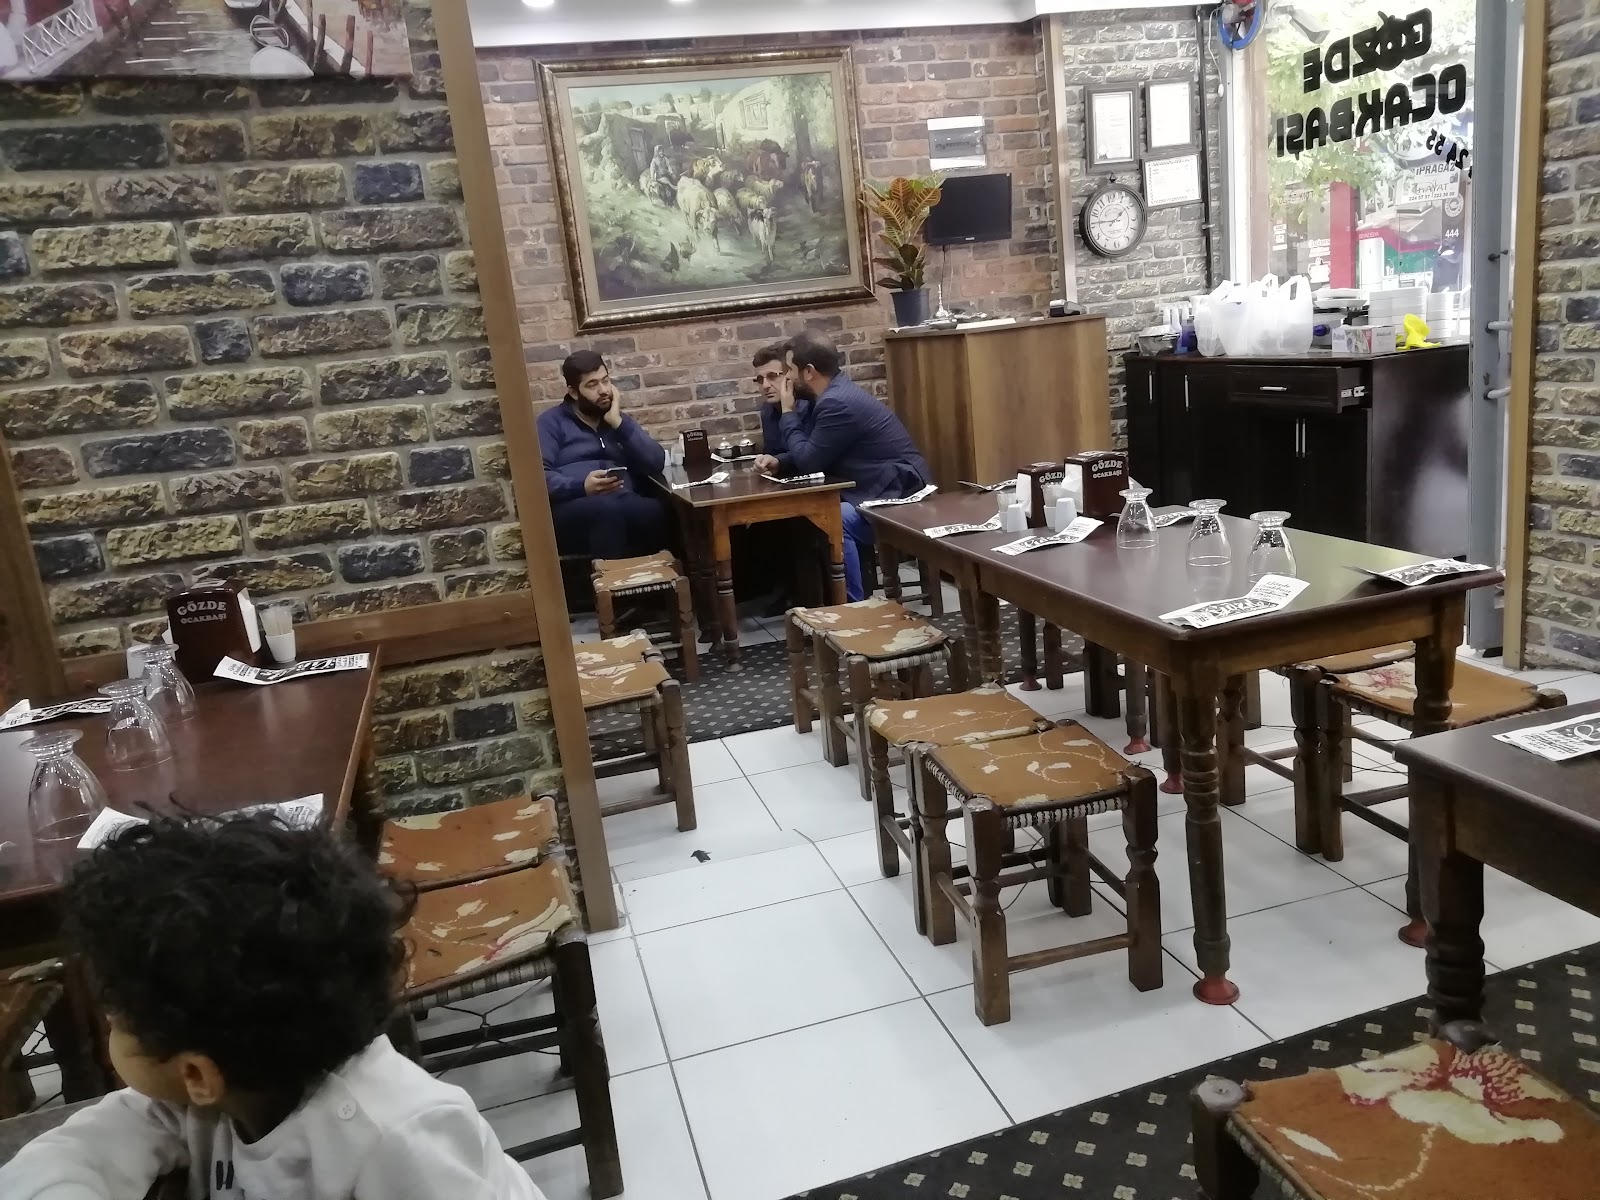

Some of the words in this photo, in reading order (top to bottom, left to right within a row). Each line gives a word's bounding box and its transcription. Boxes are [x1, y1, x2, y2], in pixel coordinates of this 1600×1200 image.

[1091, 460, 1123, 472] GÖZDE
[1039, 472, 1065, 483] GÖZD
[177, 600, 227, 615] GÖZDE
